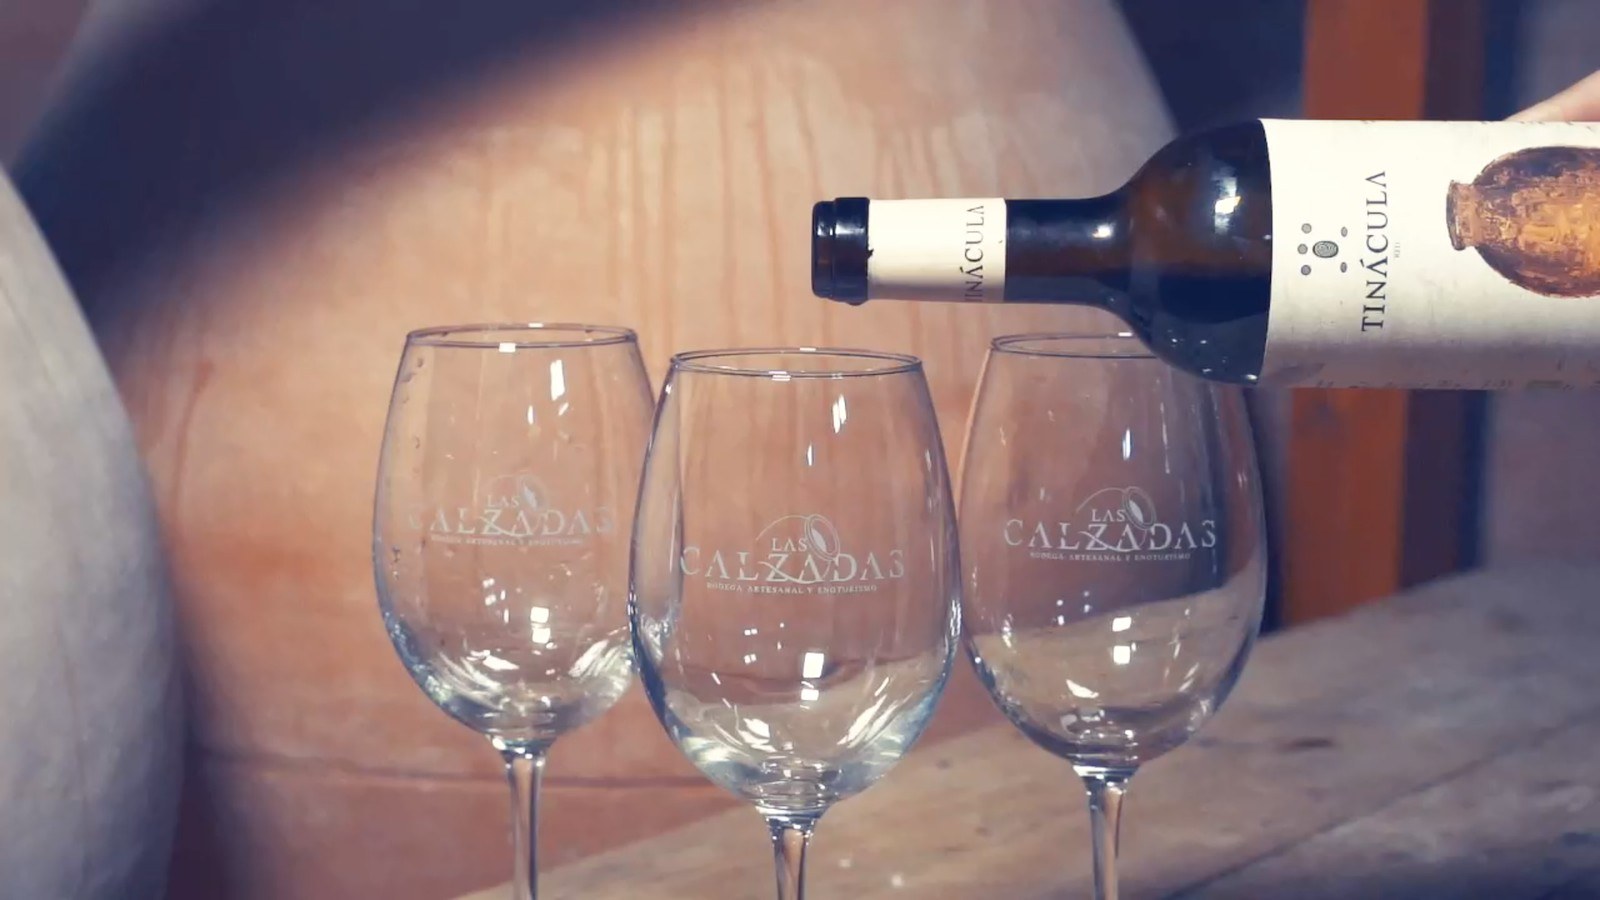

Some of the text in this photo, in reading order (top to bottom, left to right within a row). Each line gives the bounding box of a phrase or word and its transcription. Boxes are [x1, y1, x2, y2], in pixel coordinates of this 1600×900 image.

[1360, 170, 1389, 332] TINÁCULA
[487, 494, 521, 508] LAS
[1092, 508, 1126, 522] LAS
[1004, 519, 1216, 552] CALZADAS
[771, 537, 808, 552] LAS
[680, 546, 905, 584] CALZADAS
[706, 581, 878, 595] BODEGA ARTESANAL Y ENOTURISMO
